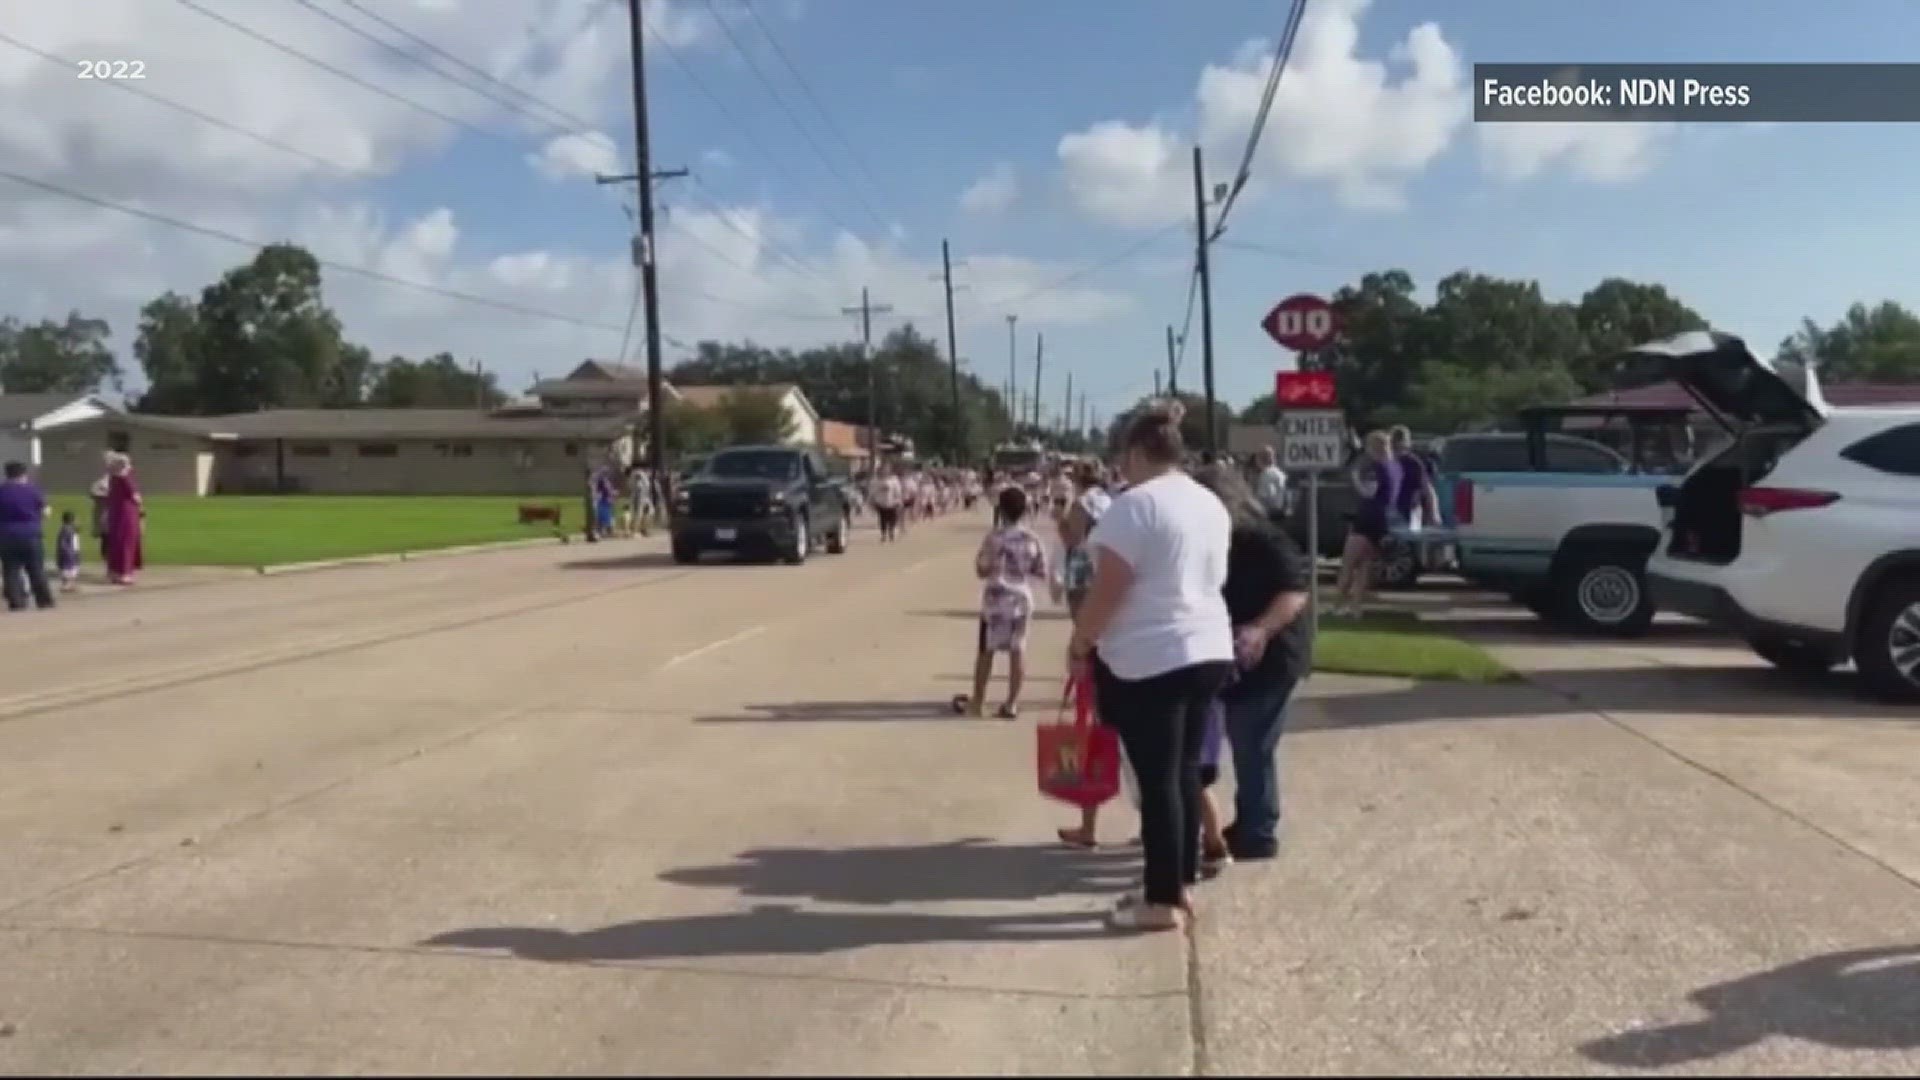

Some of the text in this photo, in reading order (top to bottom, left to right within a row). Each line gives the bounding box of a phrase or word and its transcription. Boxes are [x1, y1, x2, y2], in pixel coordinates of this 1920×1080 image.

[1278, 309, 1331, 339] DQ
[1282, 417, 1342, 435] ENTER
[1288, 444, 1336, 463] ONLY
